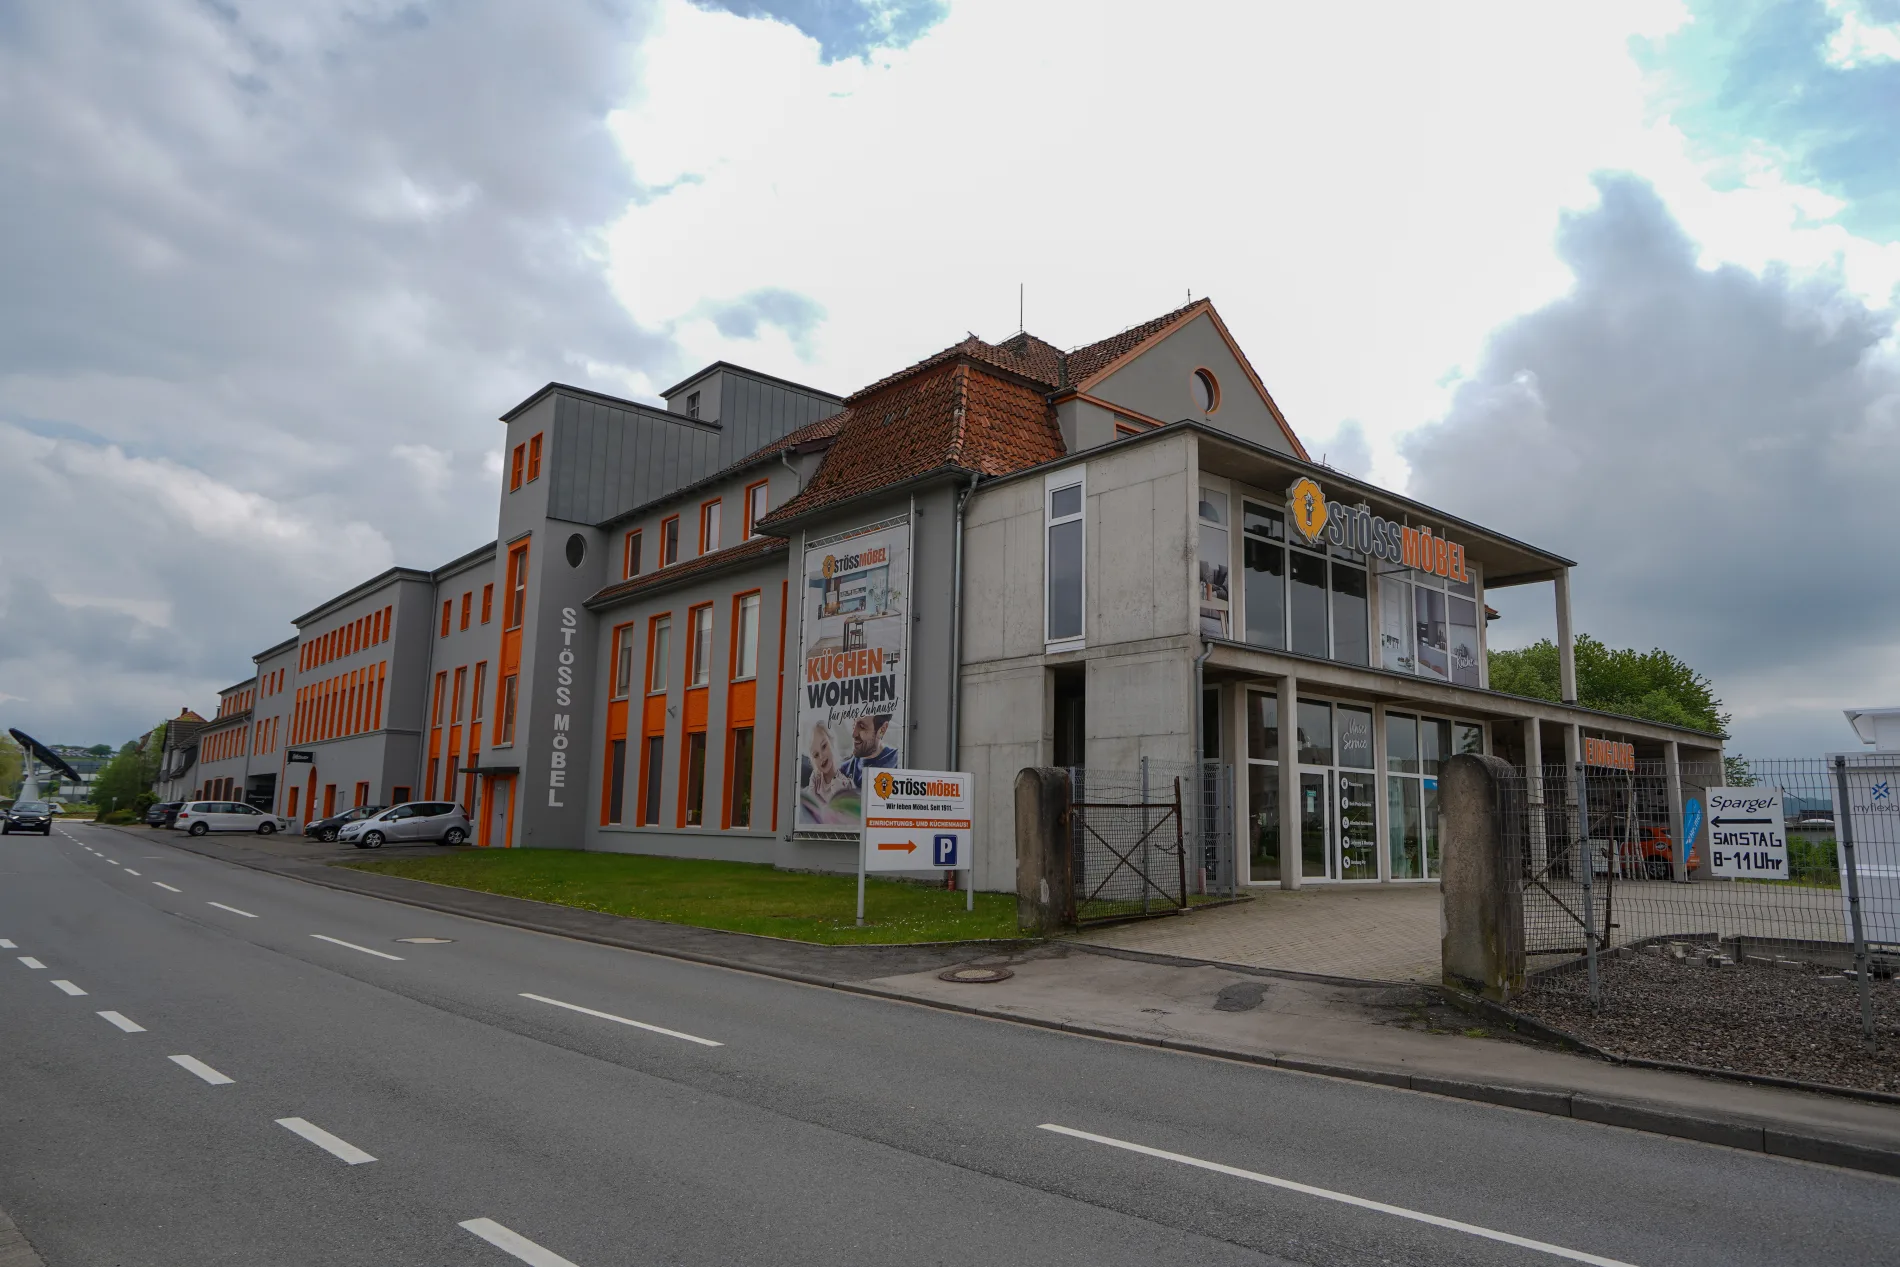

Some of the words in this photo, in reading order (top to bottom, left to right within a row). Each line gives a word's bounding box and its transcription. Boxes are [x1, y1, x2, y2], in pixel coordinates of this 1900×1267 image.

[1327, 501, 1469, 584] STÖSSMÖBEL
[834, 548, 887, 573] STÖSSMÖBEL
[556, 607, 577, 707] STÖSS
[807, 647, 883, 683] KÜCHEN
[807, 674, 896, 709] WOHNEN
[839, 705, 860, 725] jedes
[860, 697, 898, 718] Zuhause!
[1342, 732, 1367, 750] Service
[1585, 737, 1635, 771] EINGANG
[548, 713, 570, 807] MÖBEL
[892, 778, 961, 798] STÖSSMÖBEL
[1710, 795, 1778, 813] Spargel-
[929, 820, 969, 828] KÜCHENHAUS!
[940, 838, 953, 863] P
[1713, 831, 1783, 848] SAMSTAG
